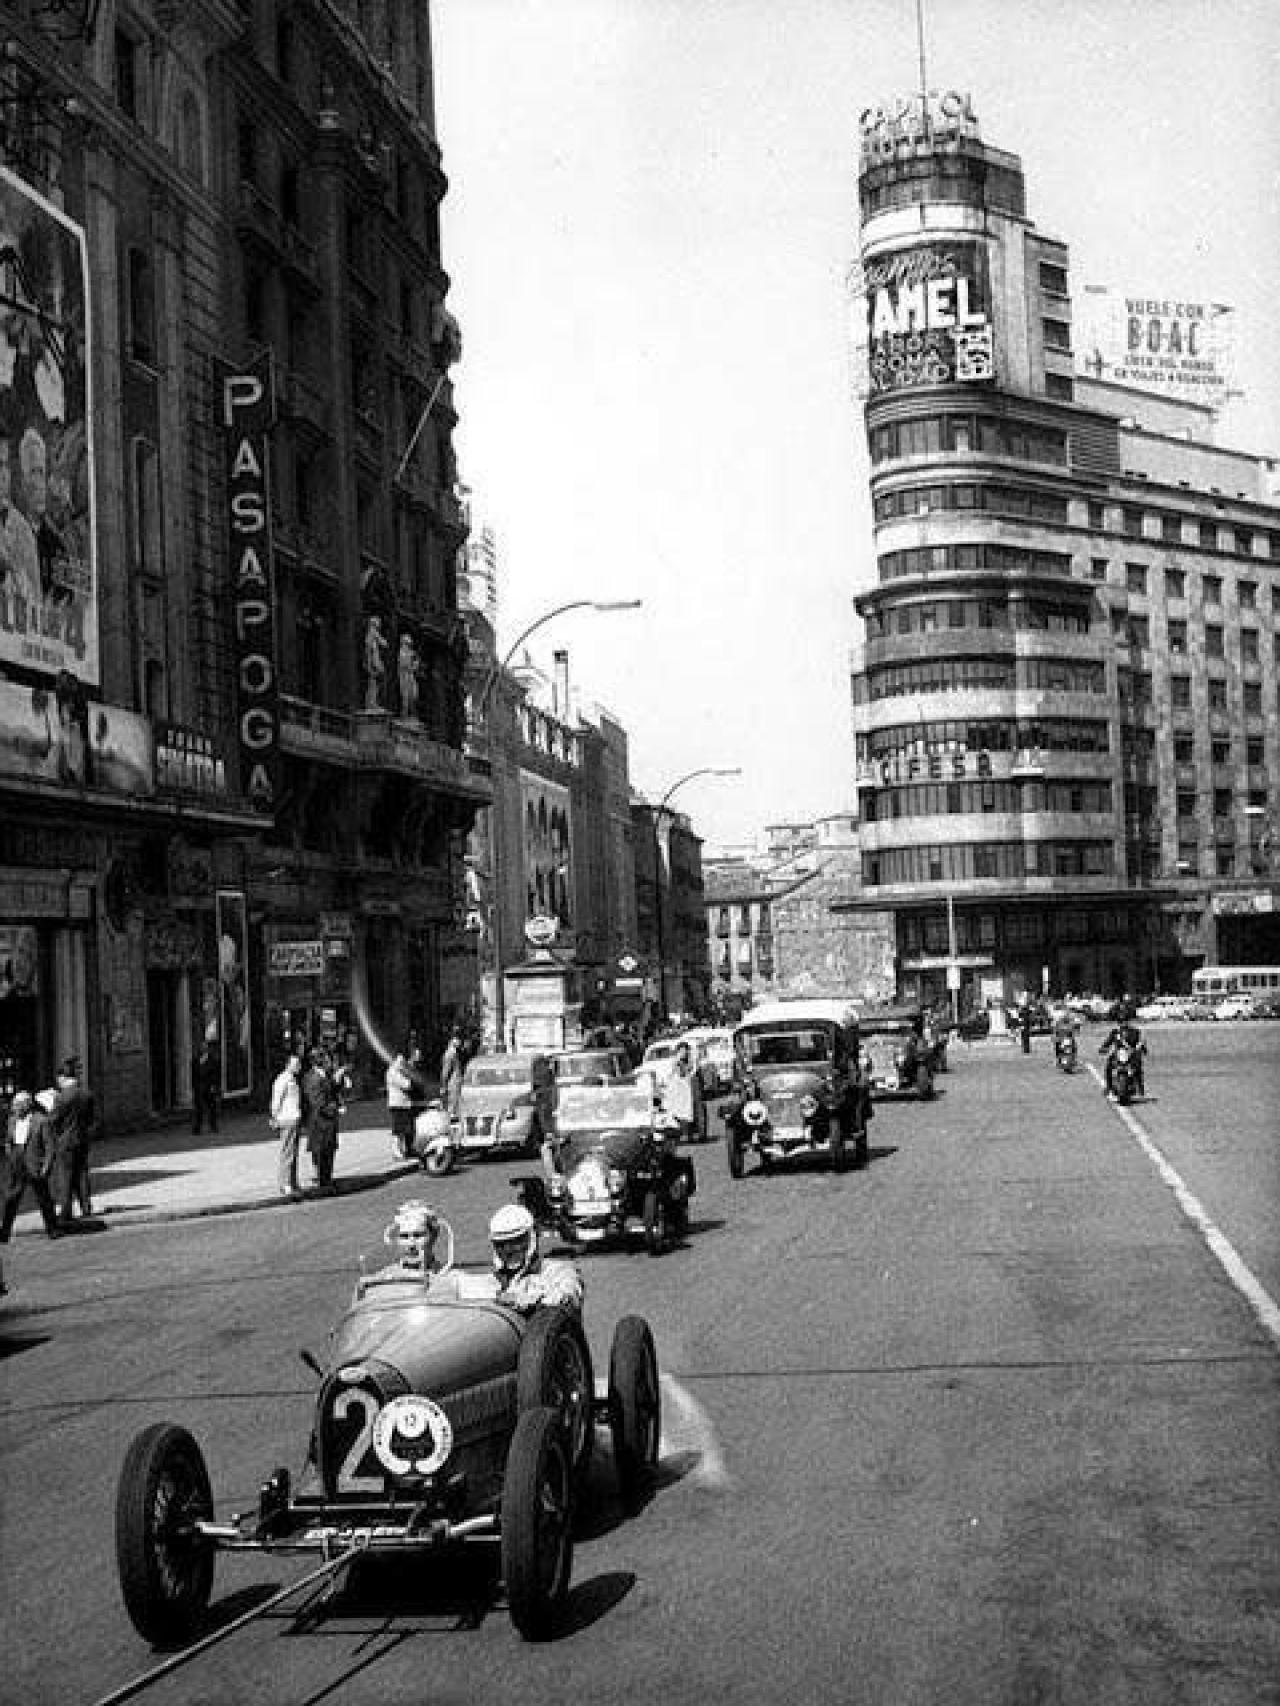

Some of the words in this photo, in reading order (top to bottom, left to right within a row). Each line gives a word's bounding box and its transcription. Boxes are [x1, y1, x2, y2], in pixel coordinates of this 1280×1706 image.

[1127, 316, 1200, 356] BOAC
[222, 374, 275, 803] PASAPOGA
[332, 1387, 385, 1494] 2
